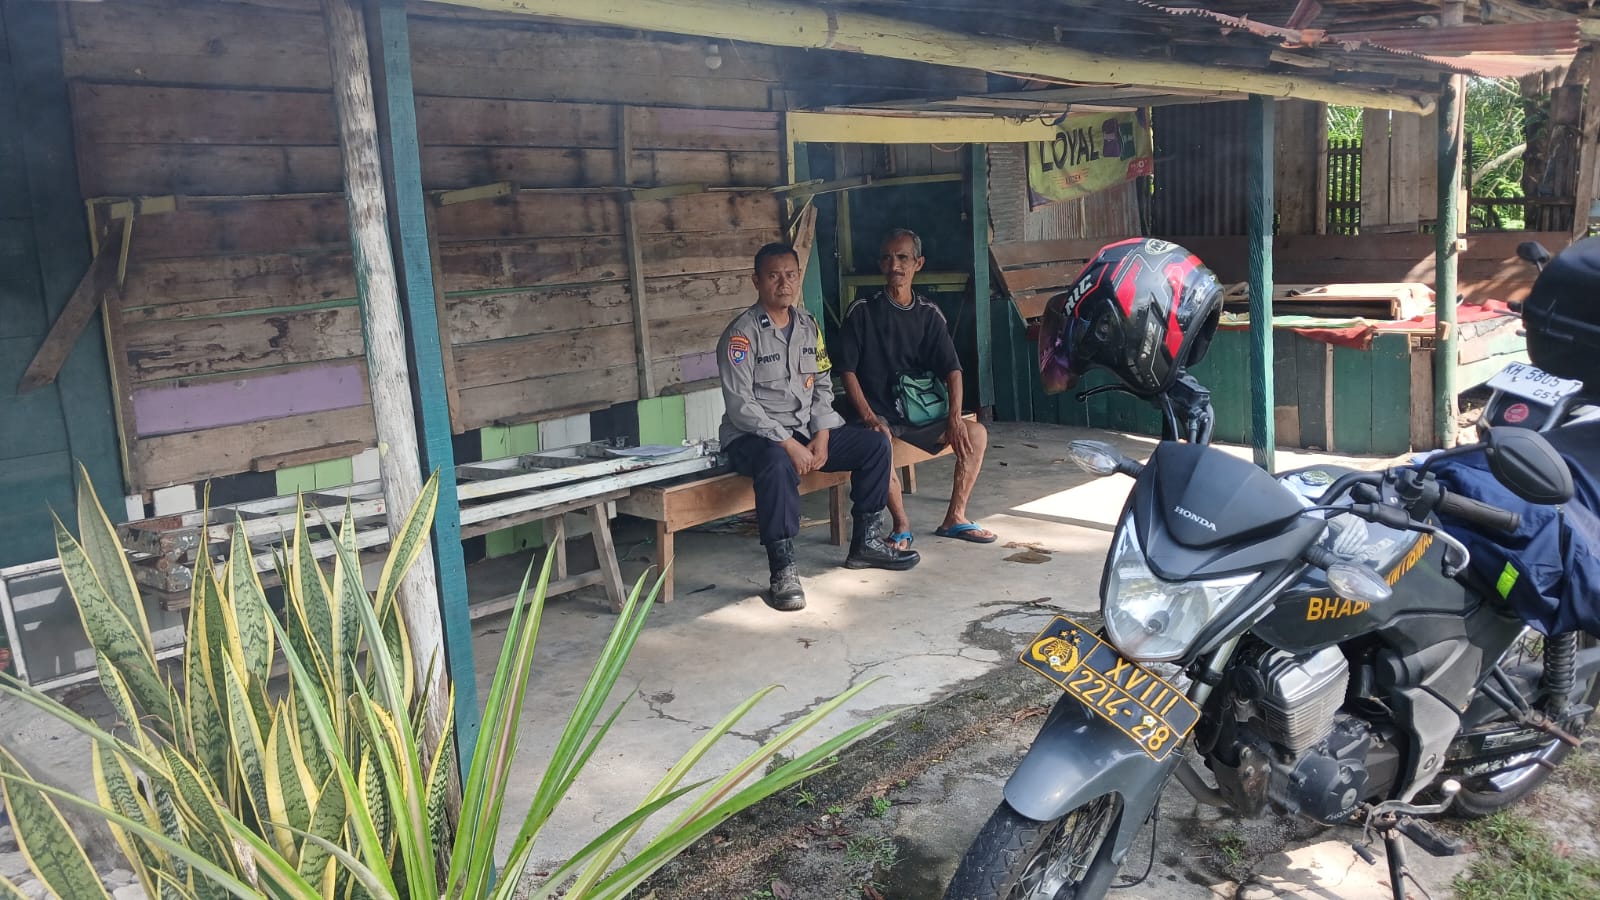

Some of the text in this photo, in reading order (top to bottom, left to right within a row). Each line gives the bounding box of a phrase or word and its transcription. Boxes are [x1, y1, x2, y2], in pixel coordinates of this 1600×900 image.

[1040, 126, 1099, 172] LOYAL
[757, 352, 781, 364] PRIYO
[1173, 506, 1217, 532] HONDA
[1105, 657, 1179, 716] XVIII
